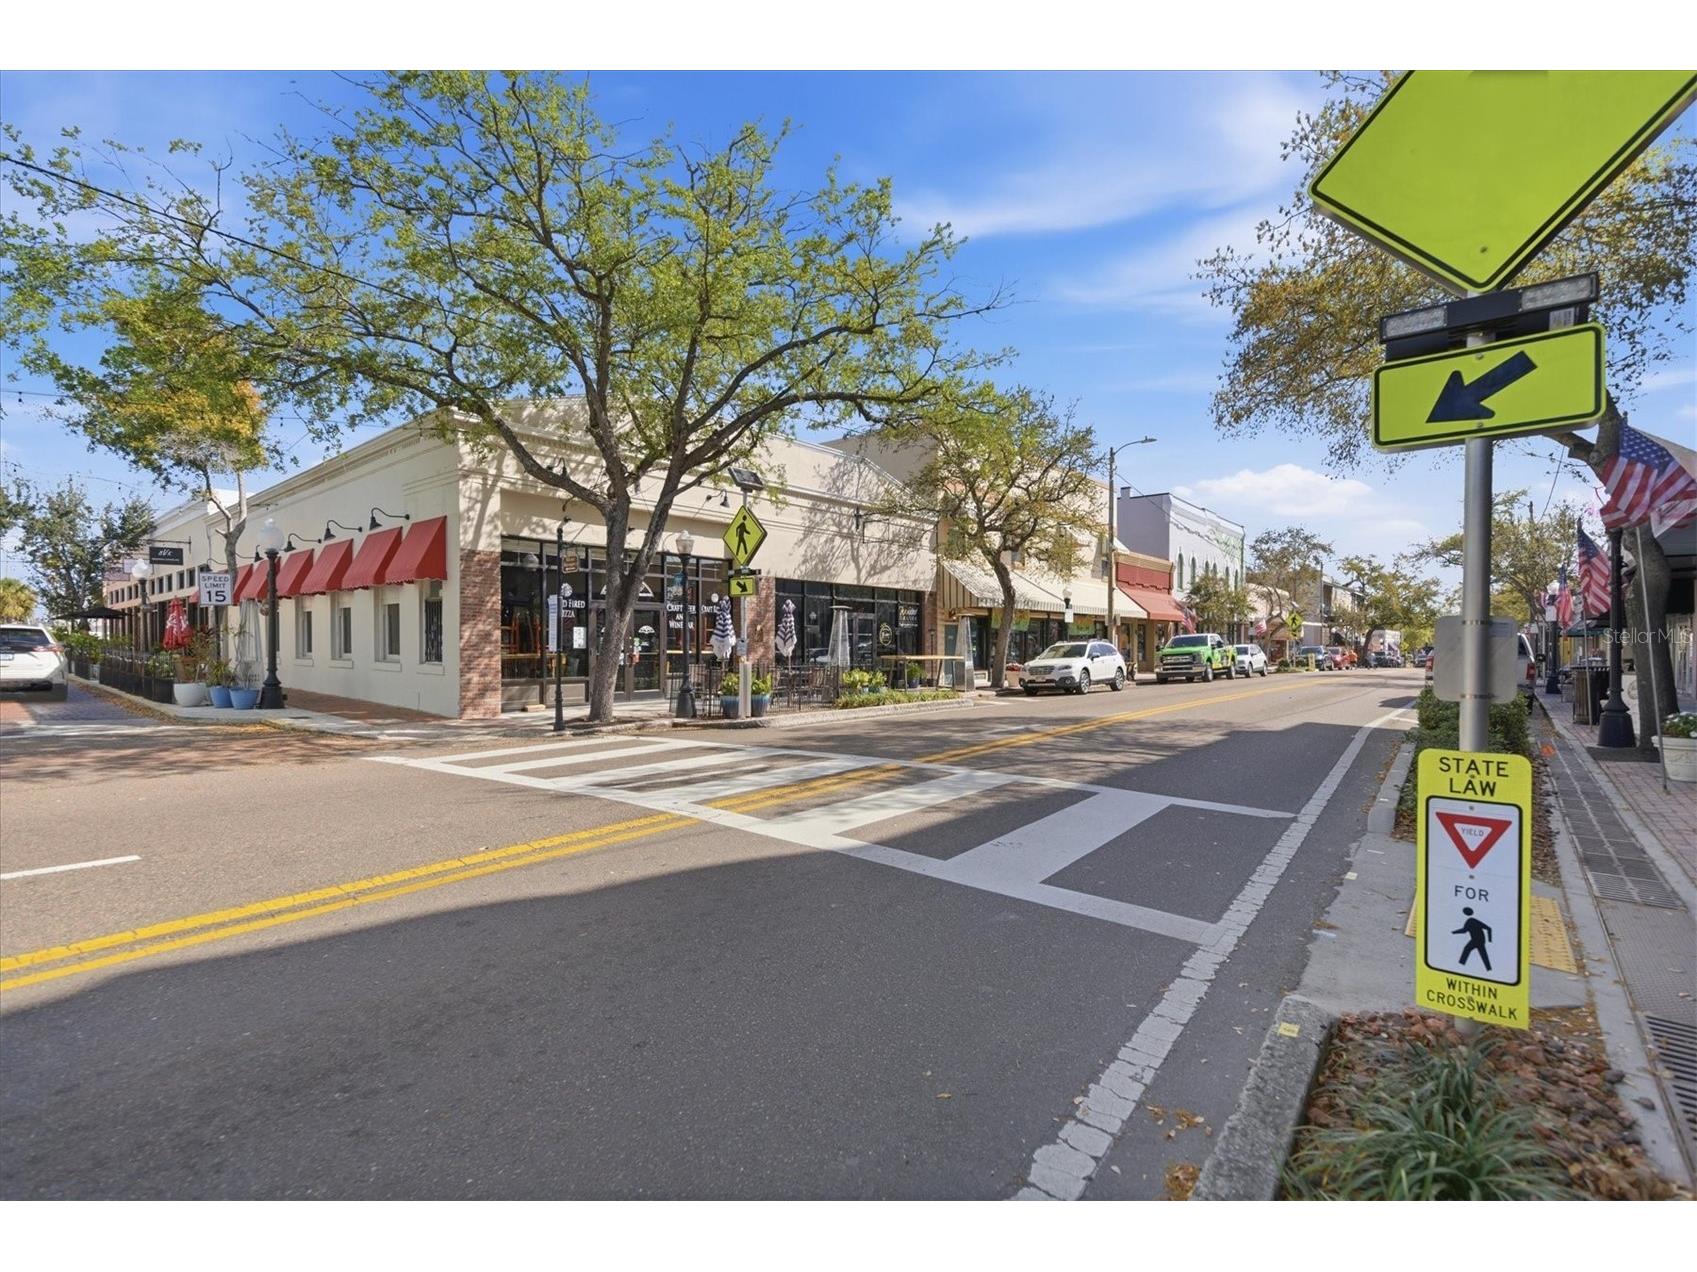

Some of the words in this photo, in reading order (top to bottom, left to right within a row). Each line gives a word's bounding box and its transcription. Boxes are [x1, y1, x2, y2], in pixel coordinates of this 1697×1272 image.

[206, 590, 226, 602] 15
[561, 609, 576, 618] IZZA
[1439, 756, 1509, 778] STATE
[1449, 777, 1497, 797] LAW
[1461, 827, 1484, 837] YIELD
[1454, 885, 1489, 902] FOR
[1446, 977, 1498, 1000] WITHIN
[1426, 989, 1517, 1020] CROSSWALK
